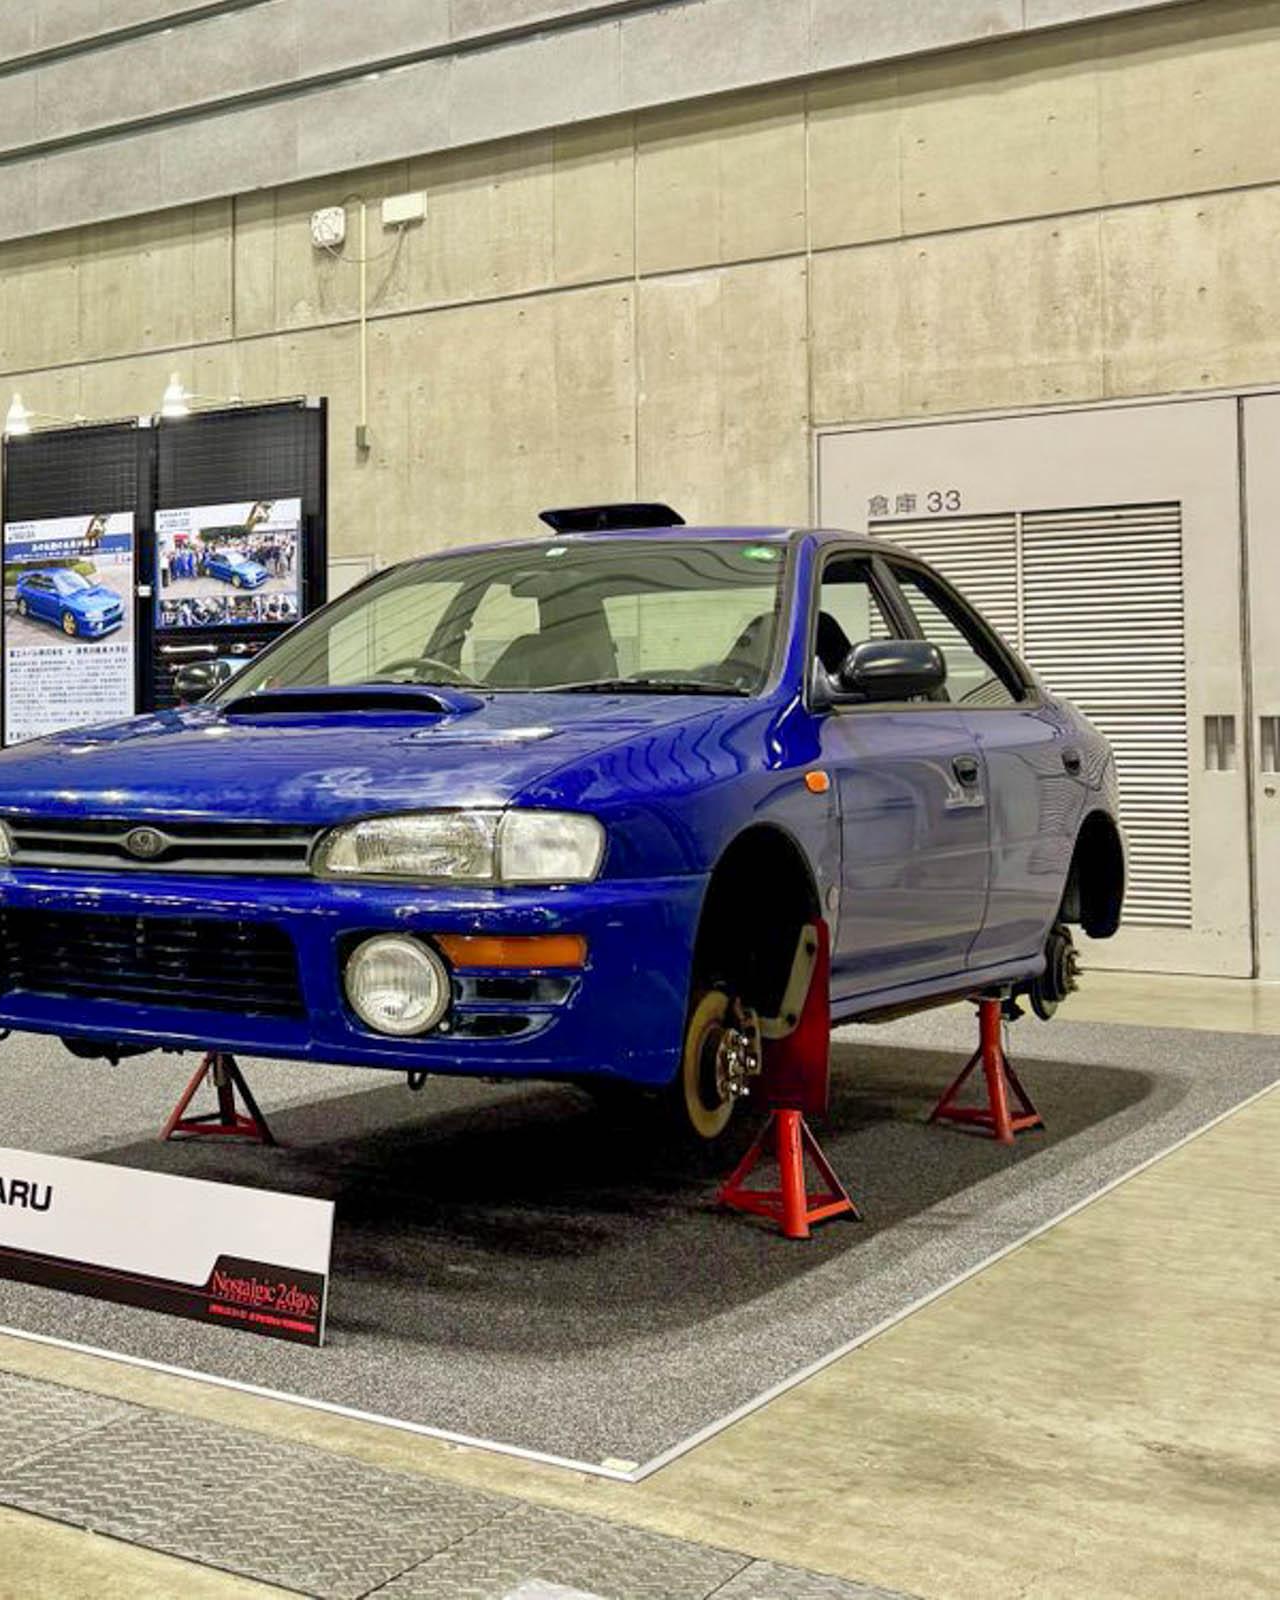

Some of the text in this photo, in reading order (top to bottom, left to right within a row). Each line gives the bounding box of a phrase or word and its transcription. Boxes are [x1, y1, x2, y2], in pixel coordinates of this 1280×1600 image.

[867, 490, 961, 516] 倉庫 33
[212, 1270, 320, 1313] Nostalgic 2days
